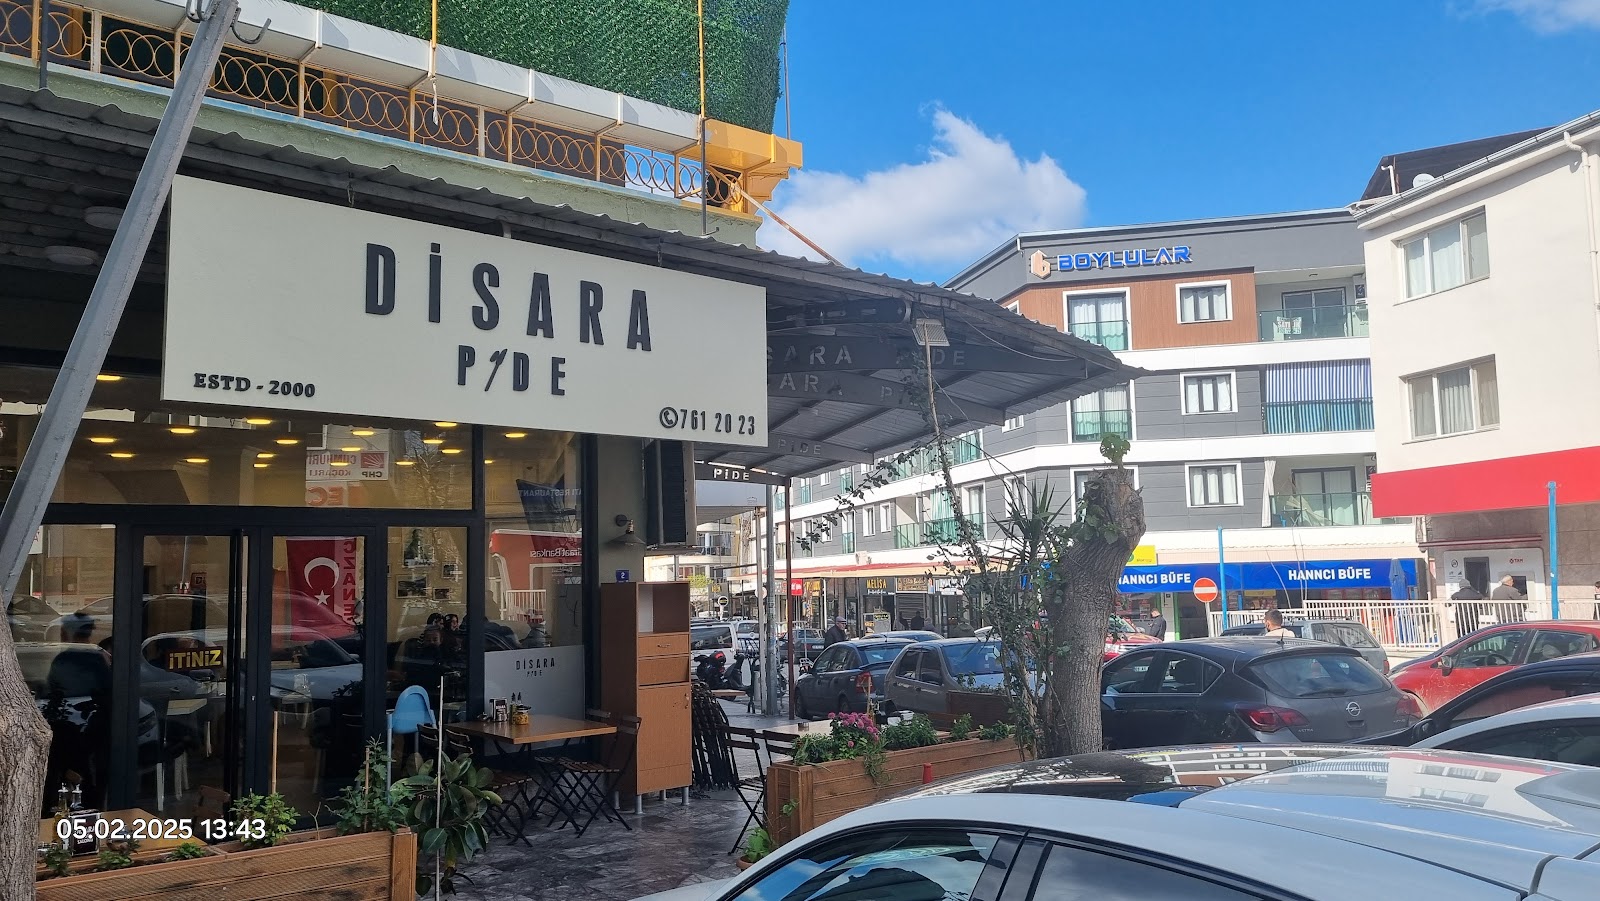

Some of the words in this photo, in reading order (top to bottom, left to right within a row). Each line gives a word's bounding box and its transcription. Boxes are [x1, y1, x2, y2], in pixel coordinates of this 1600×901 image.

[1057, 245, 1194, 271] BOYLULAR
[365, 242, 652, 352] DİSARA
[194, 373, 250, 392] ESTD
[269, 380, 316, 397] 2000
[679, 408, 706, 431] 761
[715, 412, 732, 434] 20
[739, 415, 755, 436] 23
[713, 467, 750, 481] PİDE
[1160, 571, 1191, 584] BÜFE
[1288, 568, 1336, 580] HANNCI
[1338, 566, 1371, 580] BÜFE
